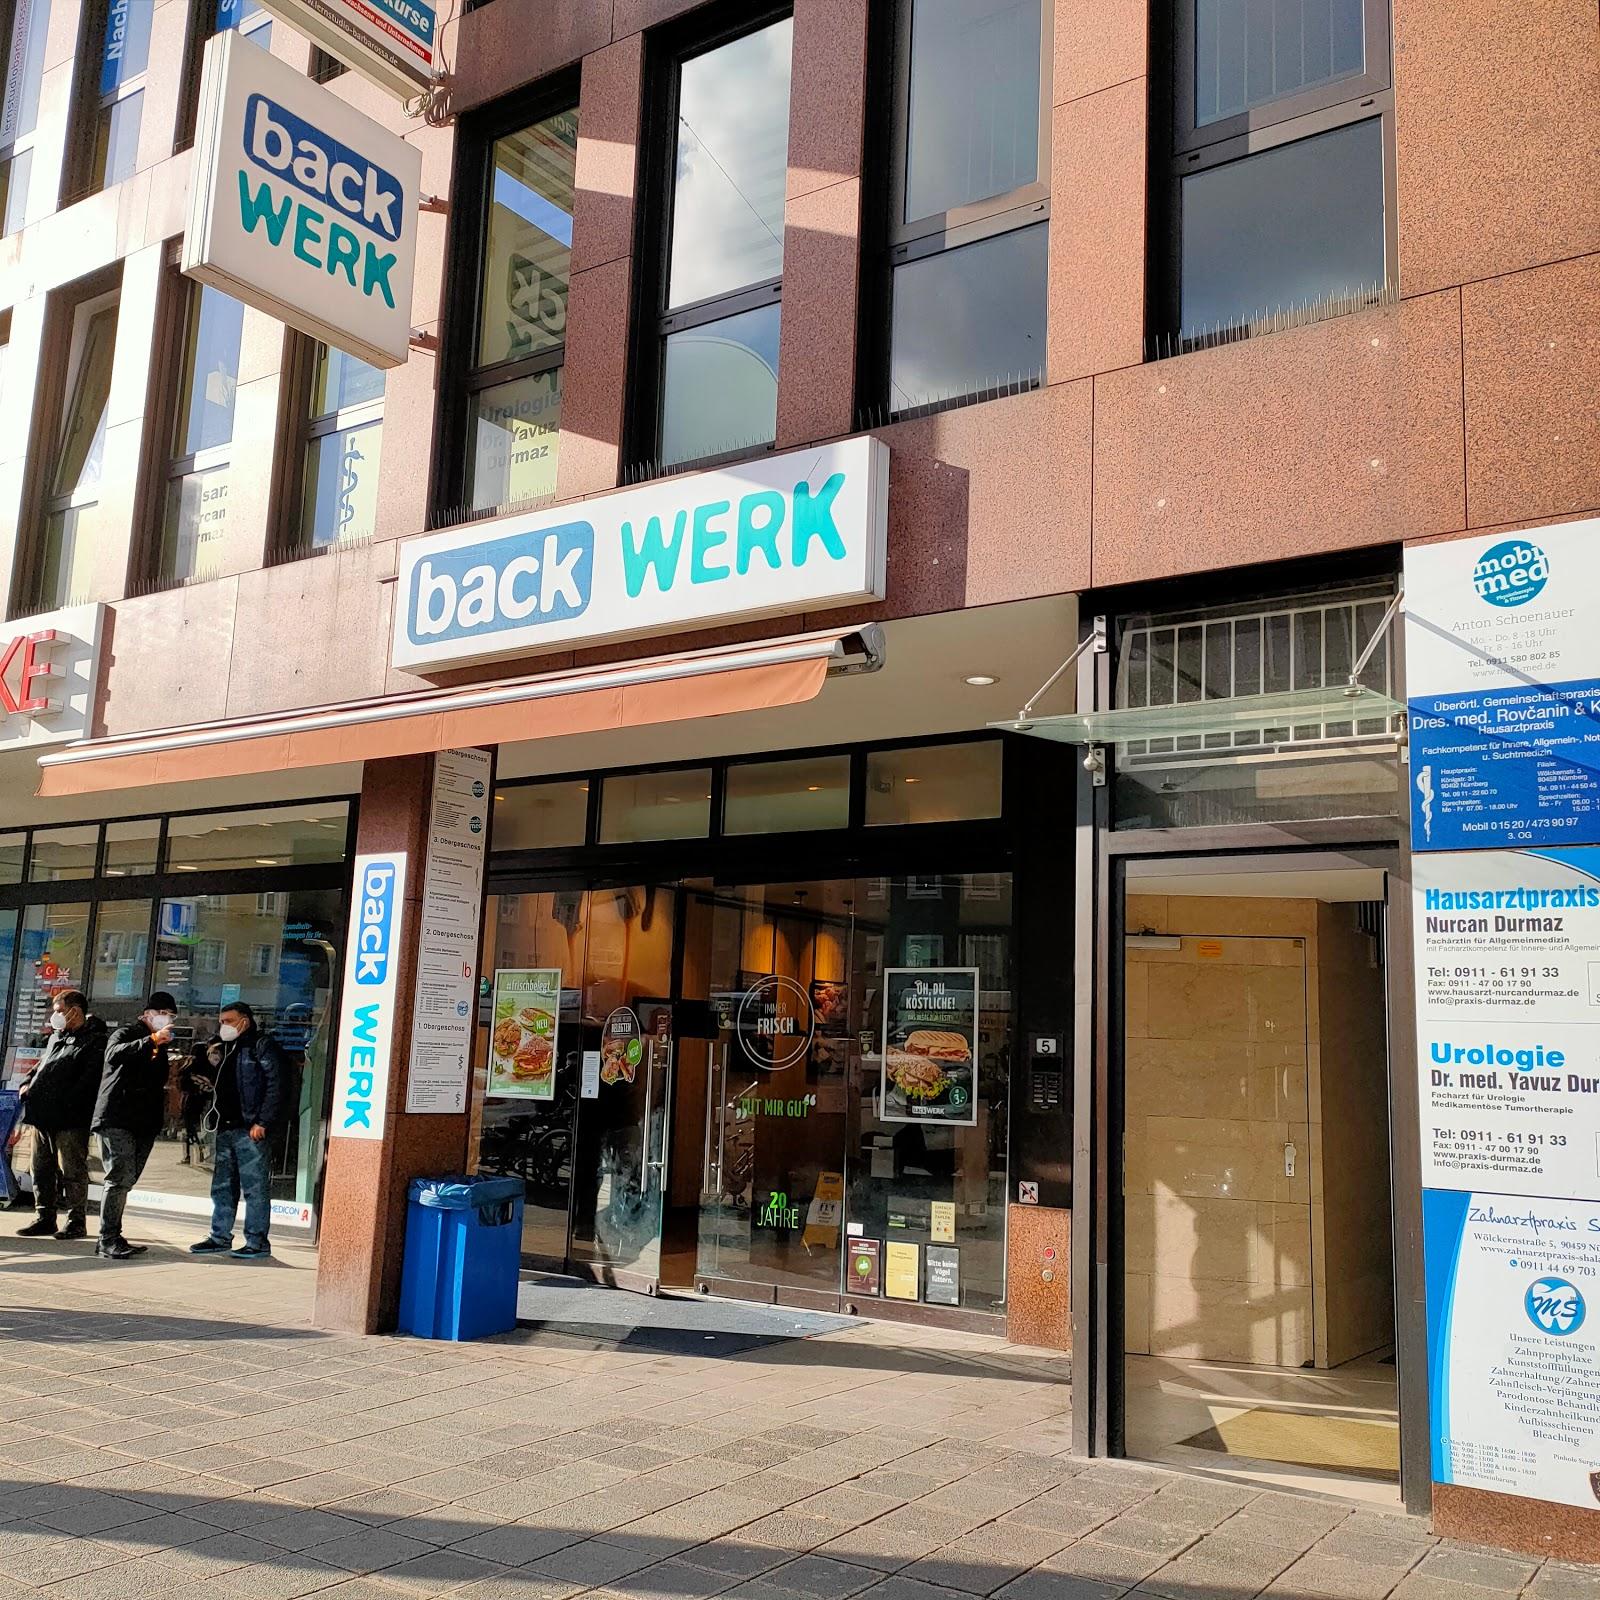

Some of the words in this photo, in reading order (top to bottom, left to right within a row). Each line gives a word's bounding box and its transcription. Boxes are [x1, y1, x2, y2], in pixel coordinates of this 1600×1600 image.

[388, 24, 424, 58] Unternehmen
[252, 100, 396, 236] back
[239, 170, 397, 309] WERK
[511, 421, 557, 442] Yavuz
[486, 444, 549, 470] Durmaz
[414, 535, 583, 636] back
[620, 473, 846, 598] WERK
[1474, 545, 1543, 577] mobi
[1474, 556, 1549, 596] med
[1451, 620, 1491, 632] Anton
[1496, 608, 1575, 626] Schoenauer
[1538, 628, 1557, 637] Uhr
[1512, 641, 1522, 650] 16
[1525, 639, 1543, 648] Uhr
[1468, 659, 1484, 668] Tel.
[1486, 657, 1508, 665] 0911
[1511, 655, 1527, 663] 580
[1434, 699, 1479, 711] Überörtl.
[1483, 688, 1600, 707] Gemeinschaftspraxis
[1413, 717, 1450, 730] Dres.
[1455, 711, 1491, 726] med.
[1497, 705, 1569, 722] Rovčanin
[1574, 702, 1586, 714] &
[1478, 720, 1554, 735] Hausarztpraxis
[1422, 743, 1487, 755] Fachkompetenz
[1489, 741, 1500, 750] für
[1492, 749, 1552, 760] Suchtmedizin
[1462, 822, 1489, 831] Mobil
[441, 838, 481, 850] Obergeschoss
[1426, 885, 1600, 911] Hausarztpraxis
[358, 869, 393, 980] back
[1426, 916, 1488, 933] Nurcan
[1495, 916, 1563, 932] Durmaz
[432, 930, 474, 940] Obergeschoss
[1489, 937, 1570, 945] Allgemeinmedizin
[1428, 968, 1450, 977] Tel:
[1454, 968, 1486, 977] 0911
[1500, 968, 1515, 977] 61
[1521, 968, 1536, 977] 91
[1542, 968, 1559, 977] 33
[933, 983, 944, 995] DU
[1428, 989, 1579, 997] www.hausarzt-nurcandurmaz.de
[764, 1003, 786, 1015] IMMER
[906, 996, 955, 1010] KÖSTLICHE!
[1428, 997, 1536, 1006] info@praxis-durmaz.de
[424, 1023, 465, 1031] Obergeschoss
[536, 1018, 548, 1030] NEU
[758, 1017, 794, 1034] FRISCH
[1041, 1040, 1050, 1053] 5
[1431, 1043, 1565, 1072] Urologie
[344, 1004, 380, 1129] WERK
[1432, 1070, 1453, 1087] Dr.
[1460, 1072, 1503, 1089] med.
[1508, 1072, 1561, 1092] Yavuz
[1568, 1075, 1600, 1093] Dur
[1487, 1095, 1525, 1103] Urologie
[764, 1099, 783, 1116] MIR
[1432, 1101, 1502, 1110] Medikamentöse
[1505, 1104, 1574, 1114] Tumortherapie
[1432, 1128, 1456, 1139] Tel:
[1460, 1130, 1492, 1142] 0911
[1507, 1132, 1522, 1143] 61
[1528, 1134, 1543, 1145] 91
[1550, 1135, 1567, 1146] 33
[1433, 1151, 1540, 1164] www.praxis-durmaz.de
[1434, 1159, 1543, 1174] info@praxis-durmaz.de
[769, 1192, 787, 1209] 20
[757, 1206, 799, 1229] JAHRE
[1469, 1207, 1576, 1235] Zahnarztpraxis
[1474, 1232, 1546, 1247] Wölckernstraße
[1561, 1241, 1586, 1250] 90459
[942, 1260, 957, 1268] keine
[1520, 1261, 1543, 1271] 0911
[1547, 1263, 1558, 1272] 44
[1563, 1264, 1575, 1273] 69
[1578, 1266, 1596, 1276] 703
[935, 1268, 950, 1277] Vögel
[1510, 1333, 1542, 1344] Unsere
[1544, 1337, 1595, 1353] Leistungen
[1515, 1347, 1592, 1365] Zahnprophylaxe
[1497, 1390, 1554, 1405] Parodontose
[1533, 1430, 1580, 1447] Bleaching
